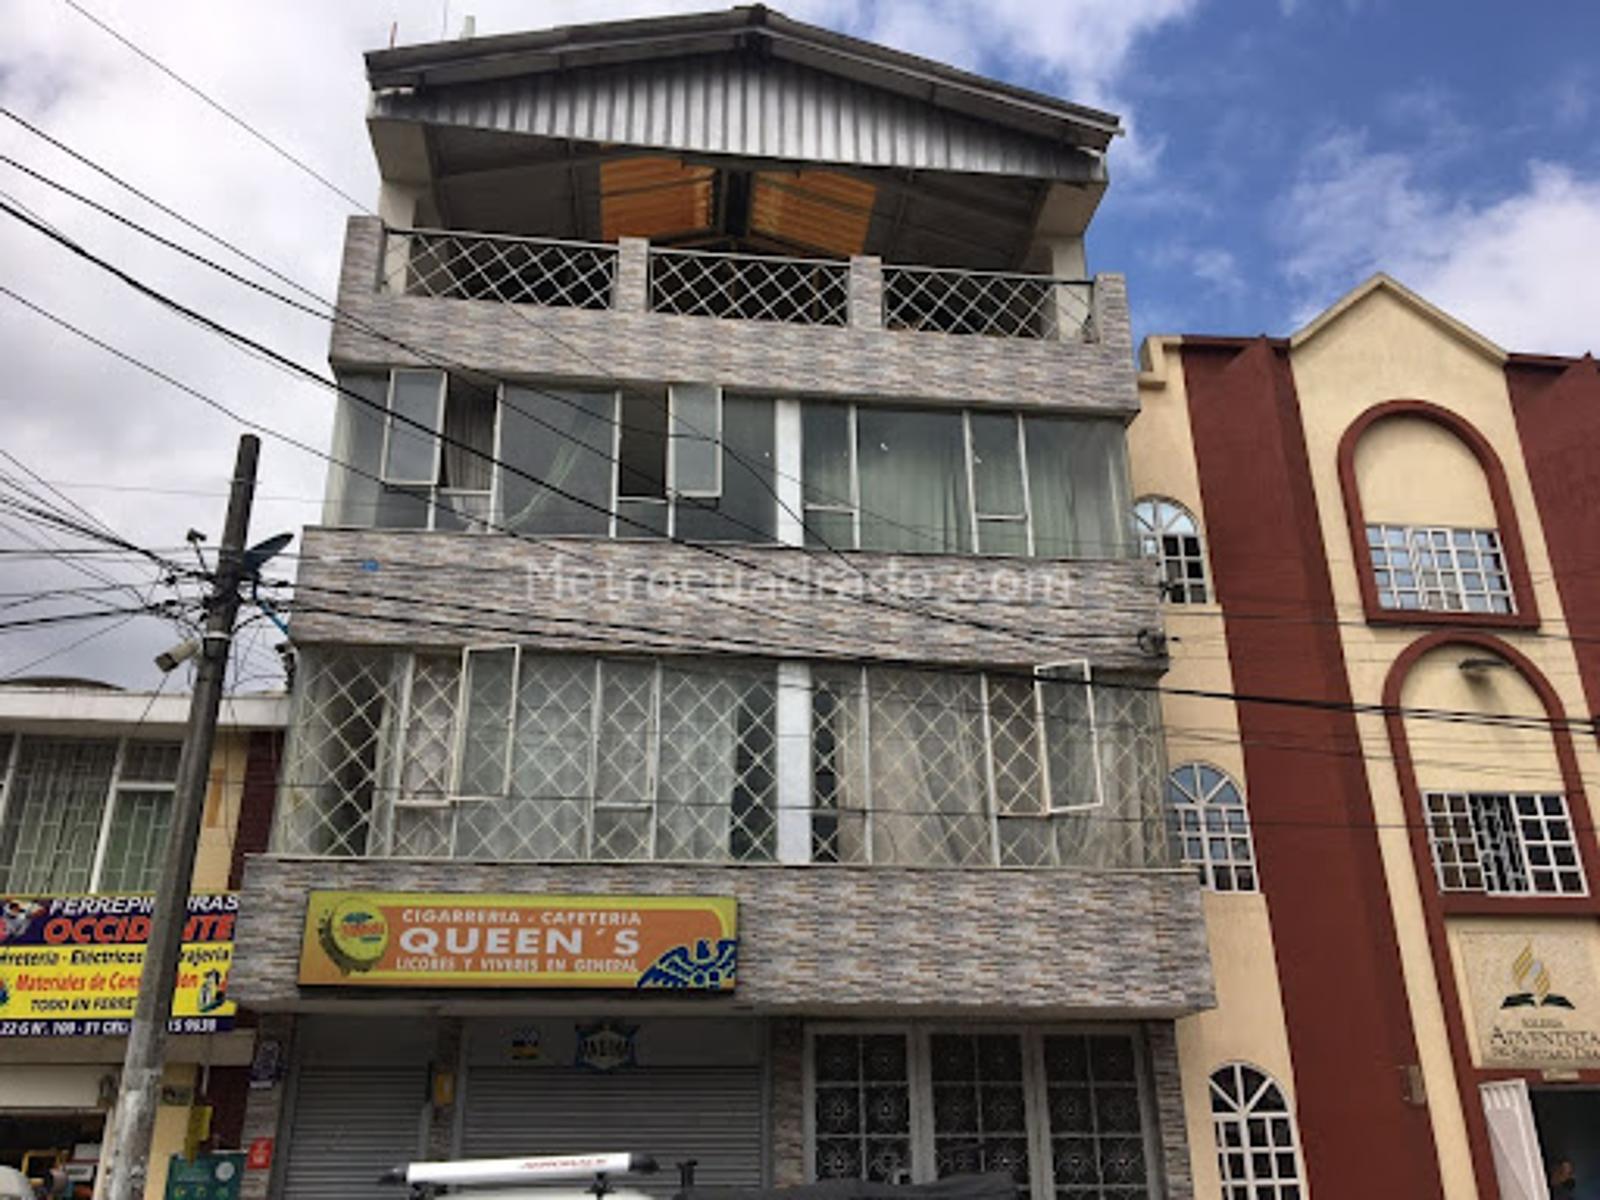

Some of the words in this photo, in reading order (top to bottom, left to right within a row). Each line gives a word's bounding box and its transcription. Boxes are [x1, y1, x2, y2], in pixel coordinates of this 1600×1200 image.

[49, 895, 239, 915] FERREPIRAS
[402, 909, 520, 924] CIGARRERIA
[540, 911, 642, 926] CAFETERIA
[43, 914, 236, 943] OCCIDTE
[396, 957, 455, 970] LICORES
[464, 957, 474, 970] Y
[480, 958, 539, 971] VIVERES
[546, 959, 567, 971] EN
[574, 958, 638, 972] GENERAL
[88, 972, 106, 990] de
